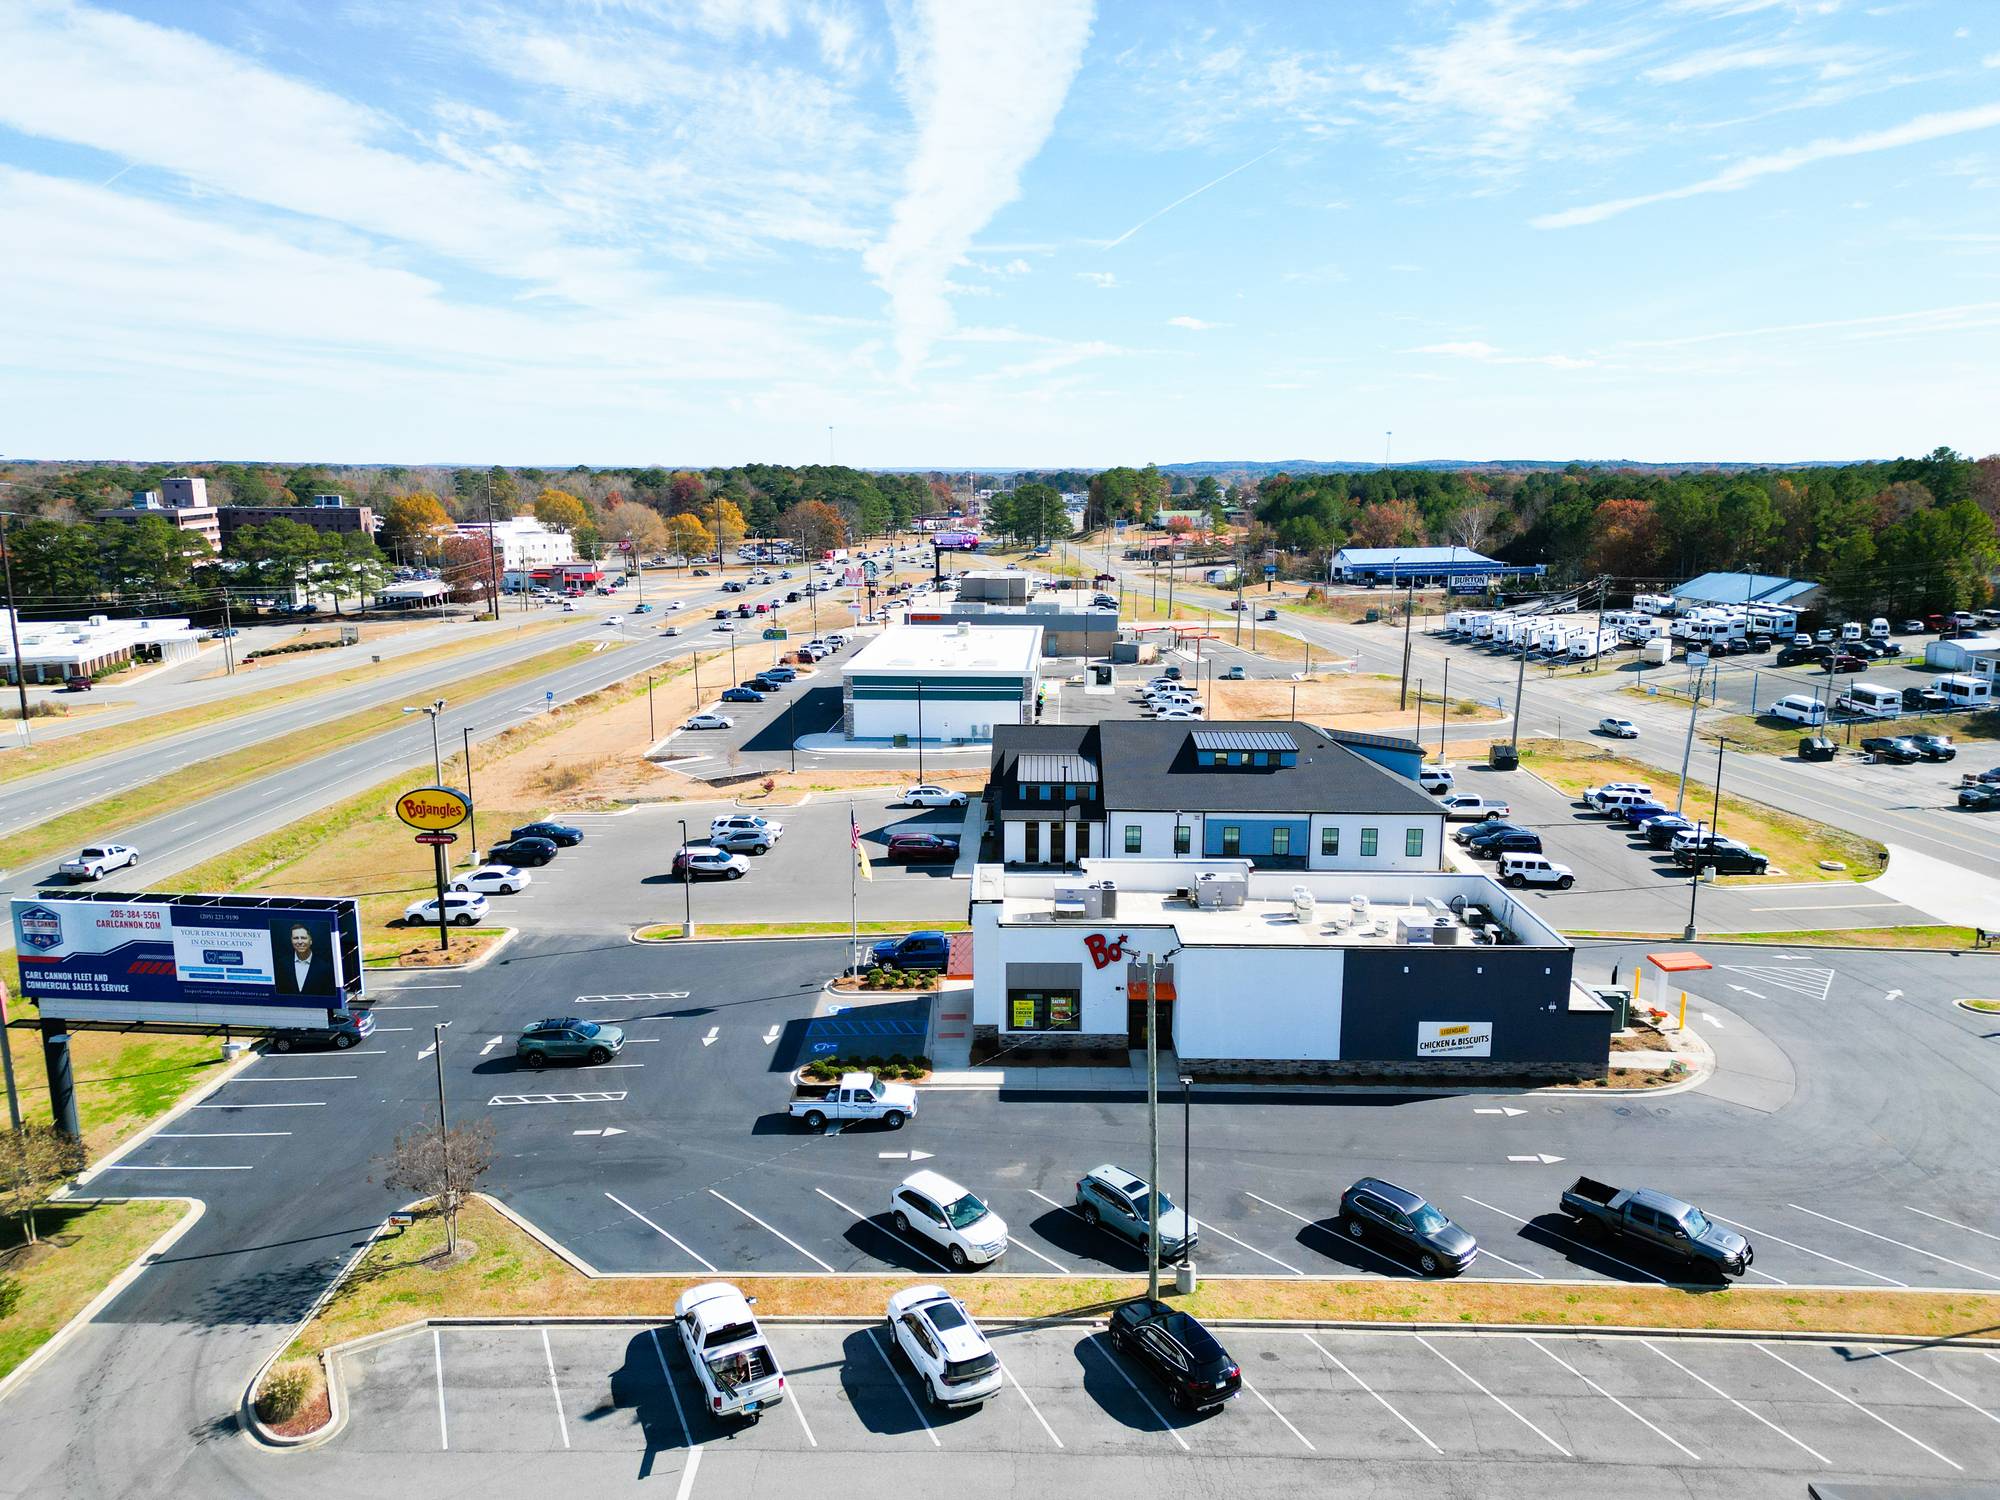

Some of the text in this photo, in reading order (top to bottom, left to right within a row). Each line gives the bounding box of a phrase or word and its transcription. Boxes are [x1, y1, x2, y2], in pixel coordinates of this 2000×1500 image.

[1454, 577, 1485, 585] BURTON
[402, 799, 462, 819] Bojangles
[110, 909, 161, 919] 205-384-5561
[23, 919, 58, 928] CARL CANNON
[96, 919, 161, 929] CARLCANNON.COM
[230, 930, 262, 938] JOURNEY
[25, 970, 108, 982] CARL CANNON FLEET AND
[26, 981, 71, 991] COMMERCIAL
[72, 983, 93, 991] SALES
[101, 983, 130, 992] SERVICE
[1441, 1026, 1467, 1035] LEGENDARY
[1420, 1039, 1450, 1050] CHICKEN
[1458, 1034, 1489, 1046] BISCUITS
